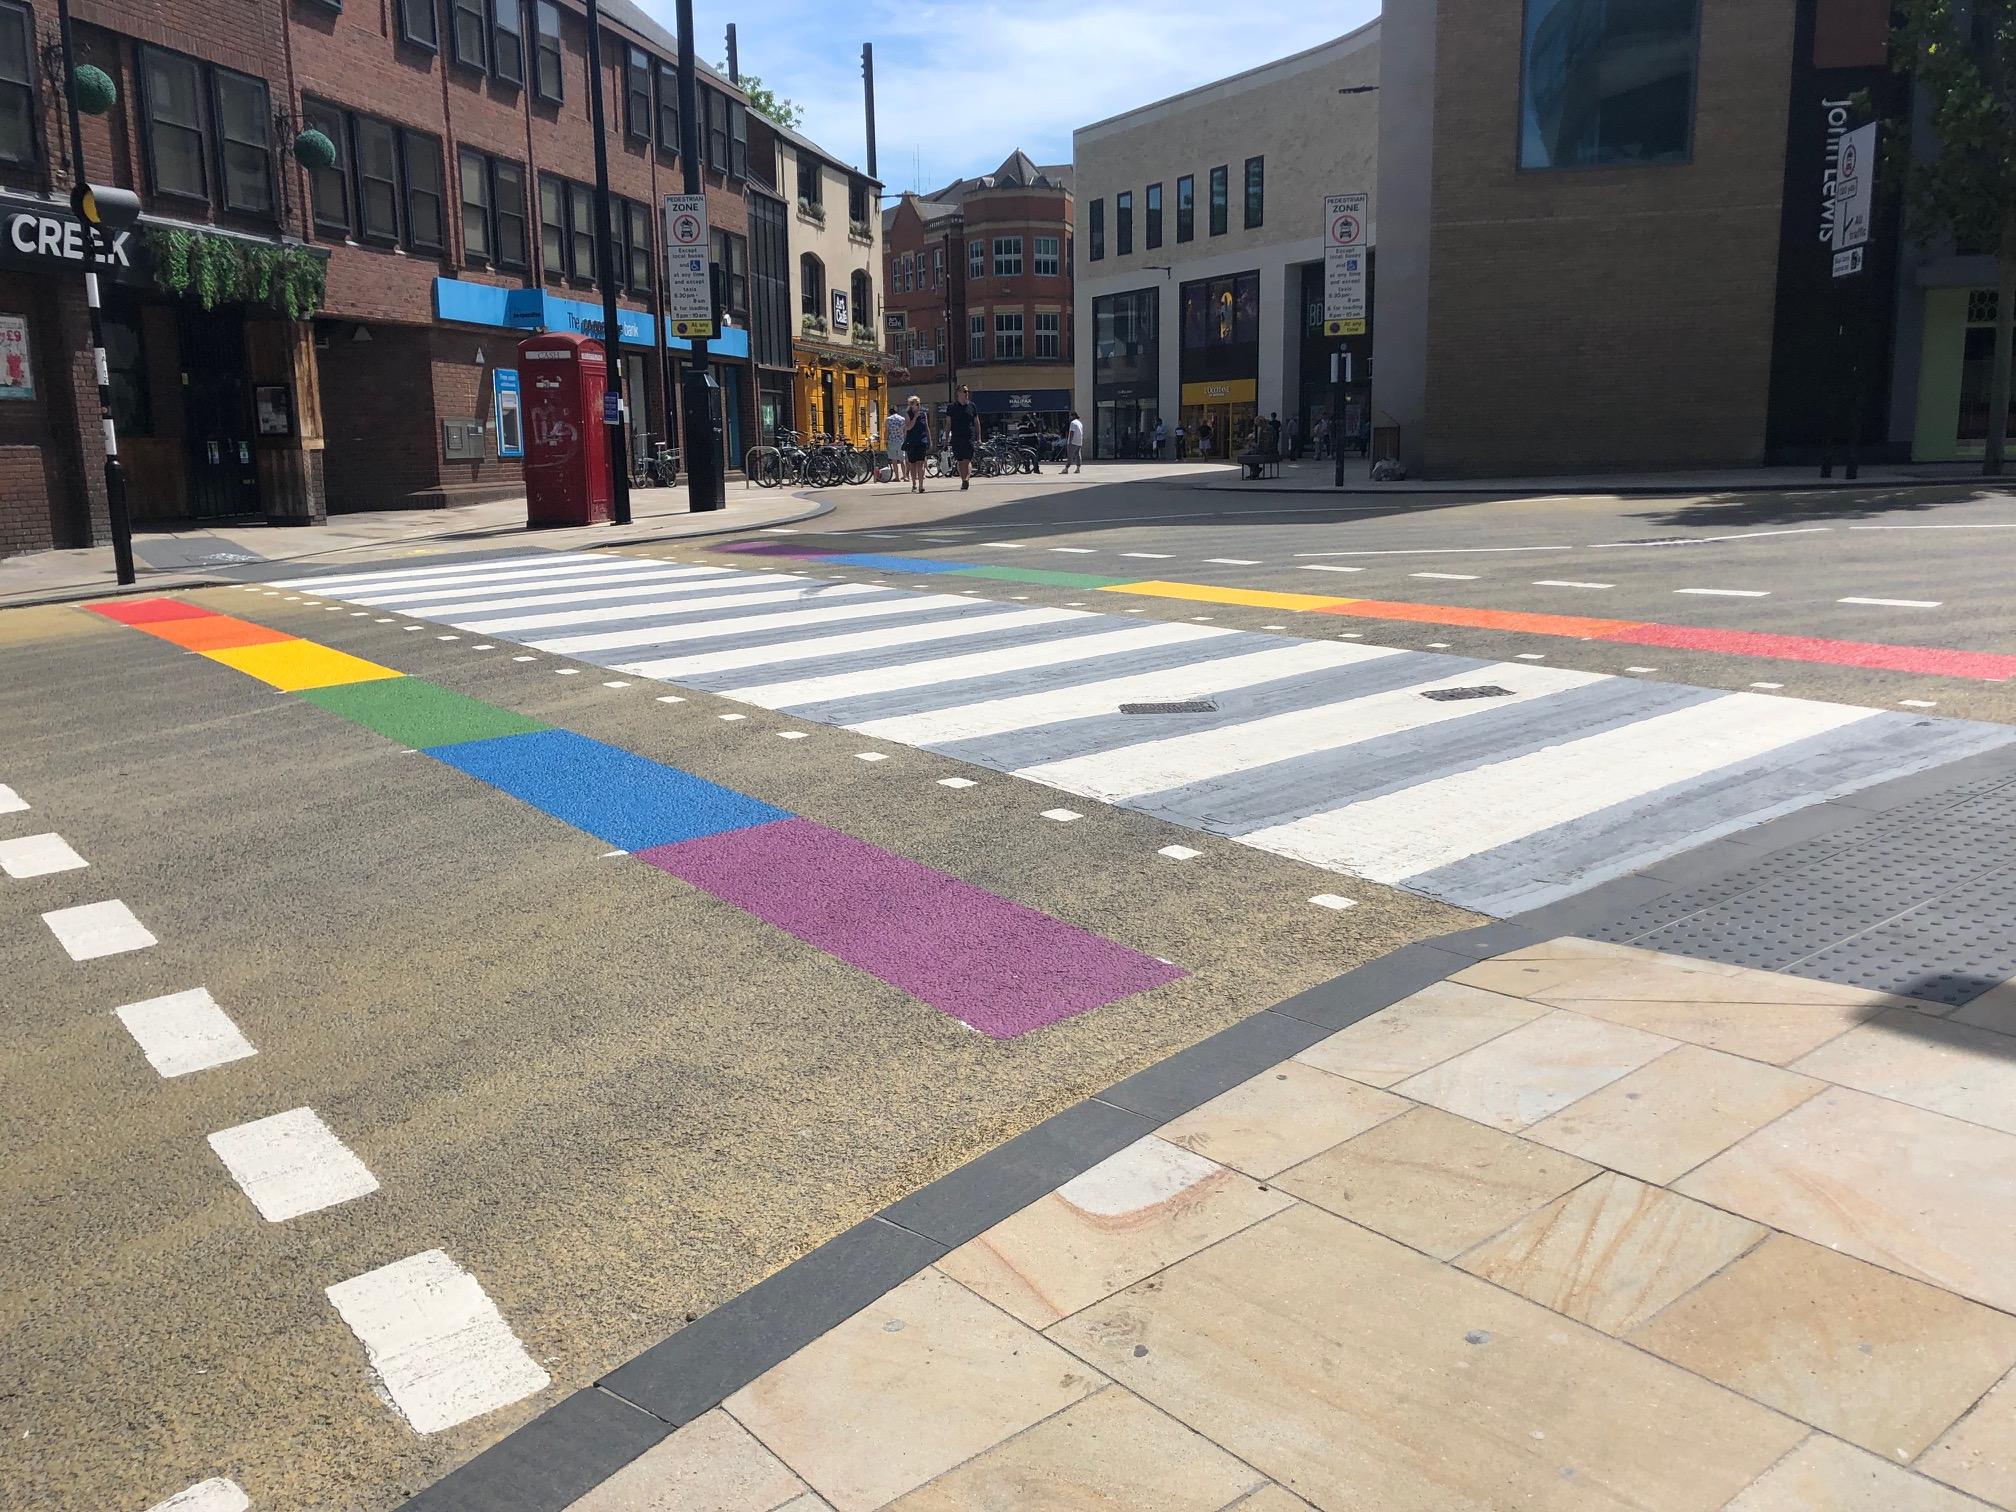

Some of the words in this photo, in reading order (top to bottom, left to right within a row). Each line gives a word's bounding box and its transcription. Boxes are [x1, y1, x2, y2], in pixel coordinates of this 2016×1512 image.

[1327, 196, 1365, 204] PEDESTRIAN
[673, 203, 699, 211] ZONE
[1333, 203, 1360, 213] ZONE
[567, 311, 580, 330] The
[622, 321, 639, 338] bank
